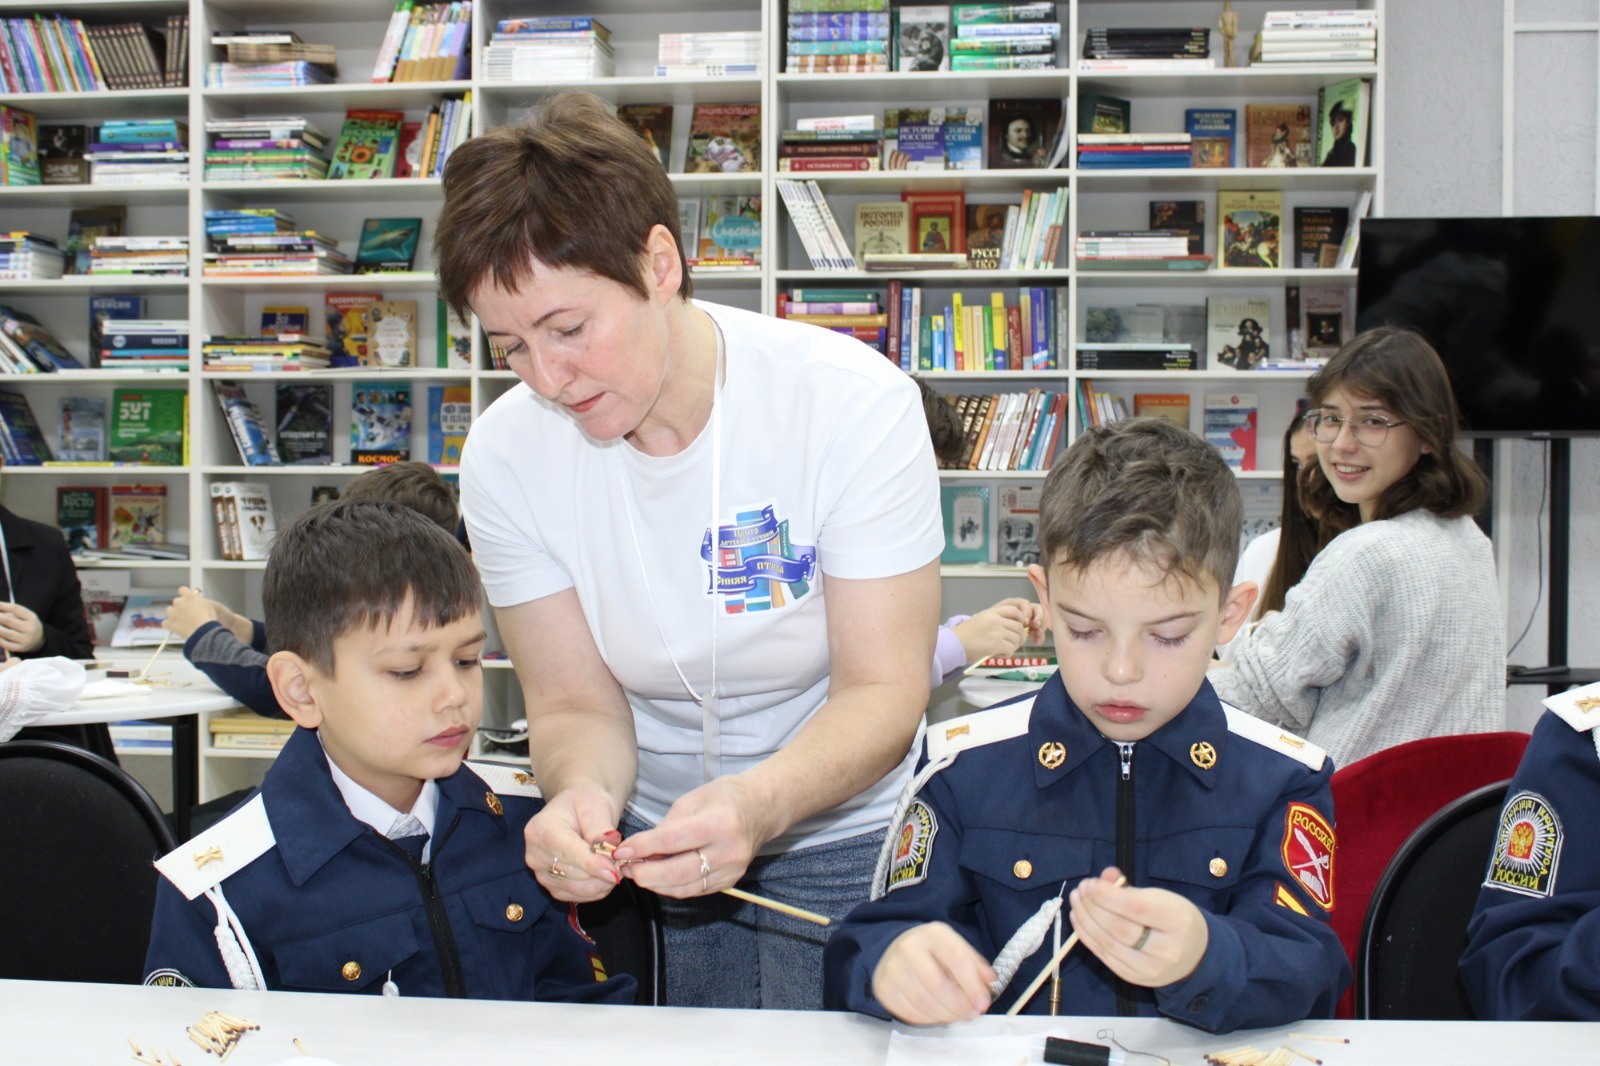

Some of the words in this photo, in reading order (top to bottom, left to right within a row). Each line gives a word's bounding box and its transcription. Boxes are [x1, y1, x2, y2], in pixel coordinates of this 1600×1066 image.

[697, 106, 759, 115] ЭНЦИКЛОПЕДИЯ
[860, 211, 903, 220] ИСТОРИЯ
[862, 220, 901, 228] РОССИИ
[357, 454, 401, 463] КОСМОС
[1293, 811, 1335, 853] РОССИЯ
